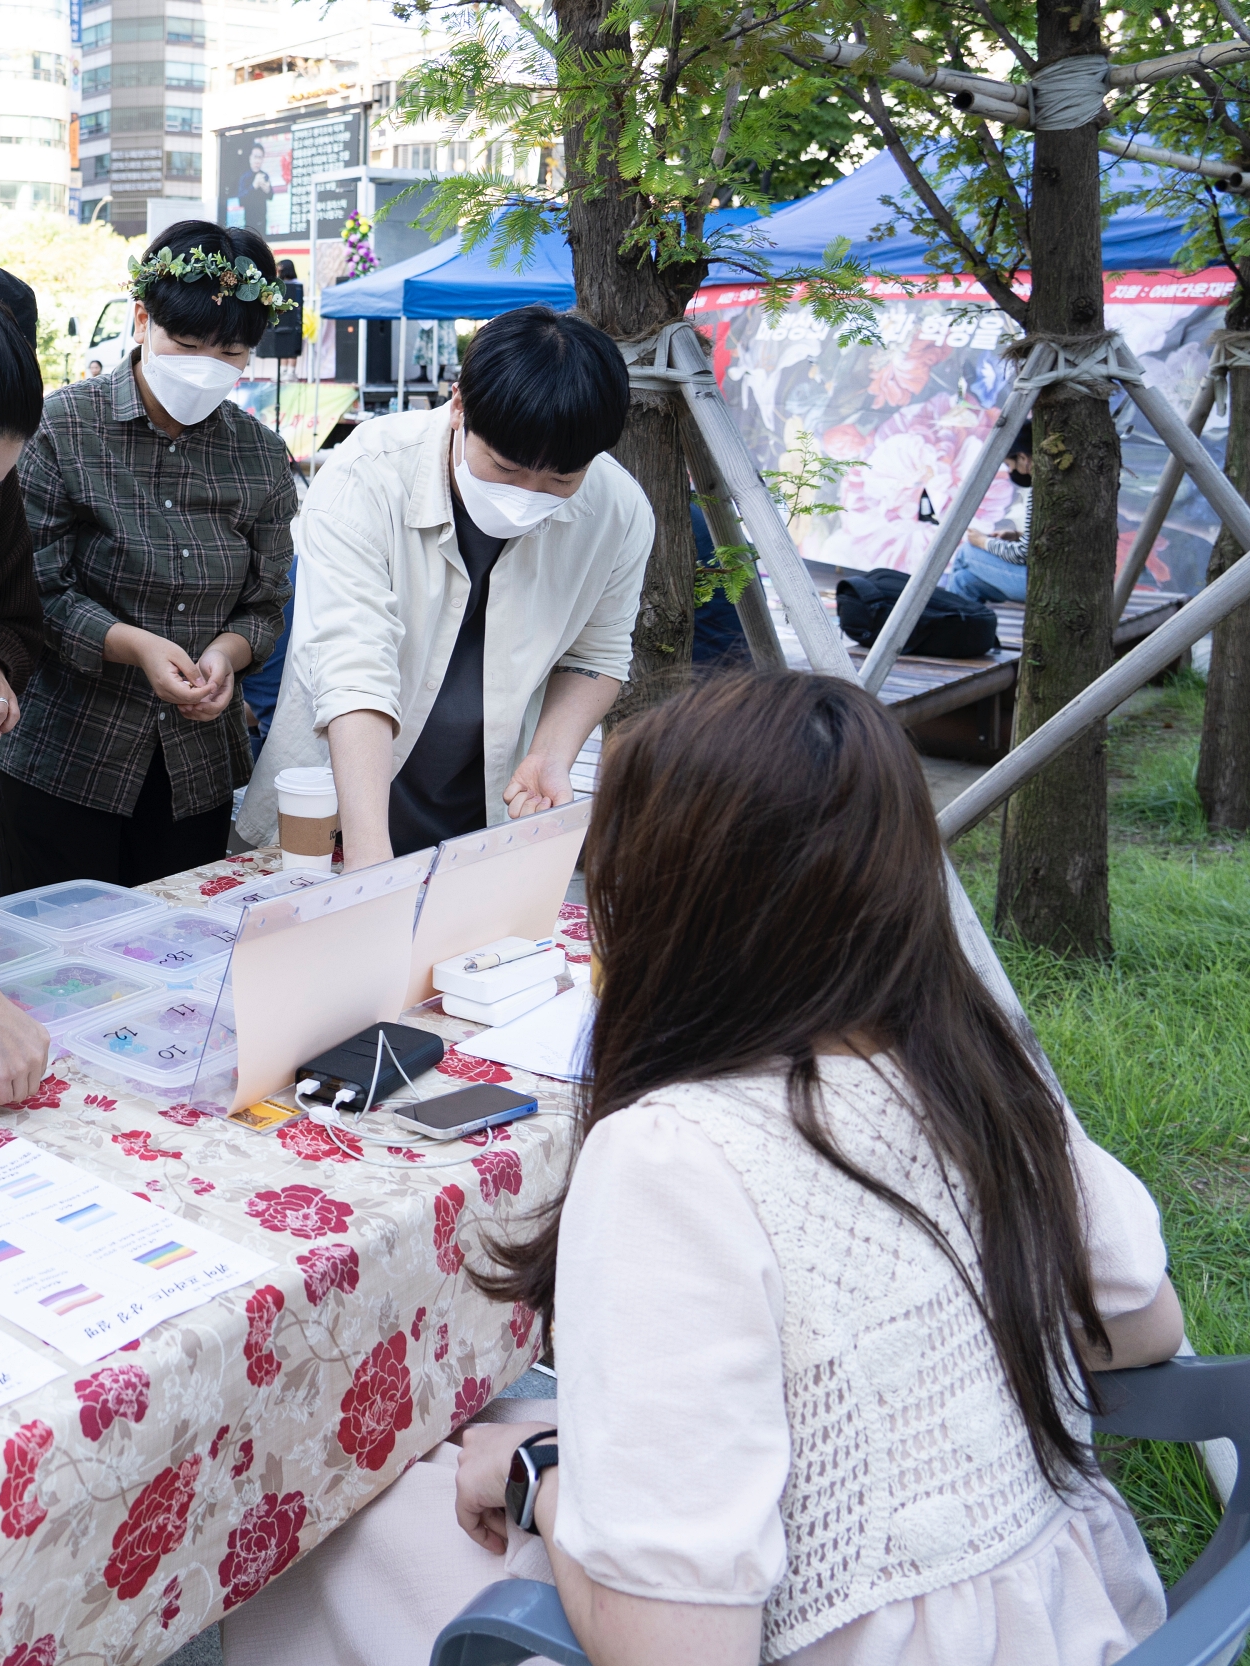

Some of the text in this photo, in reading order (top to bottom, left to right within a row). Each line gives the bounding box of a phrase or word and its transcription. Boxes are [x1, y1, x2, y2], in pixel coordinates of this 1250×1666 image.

[102, 1026, 139, 1041] 12
[158, 1044, 188, 1060] 10
[202, 1263, 230, 1279] 퀴어
[148, 1275, 199, 1303] 프라이드
[116, 1302, 143, 1324] 상징
[83, 1319, 111, 1339] 설명
